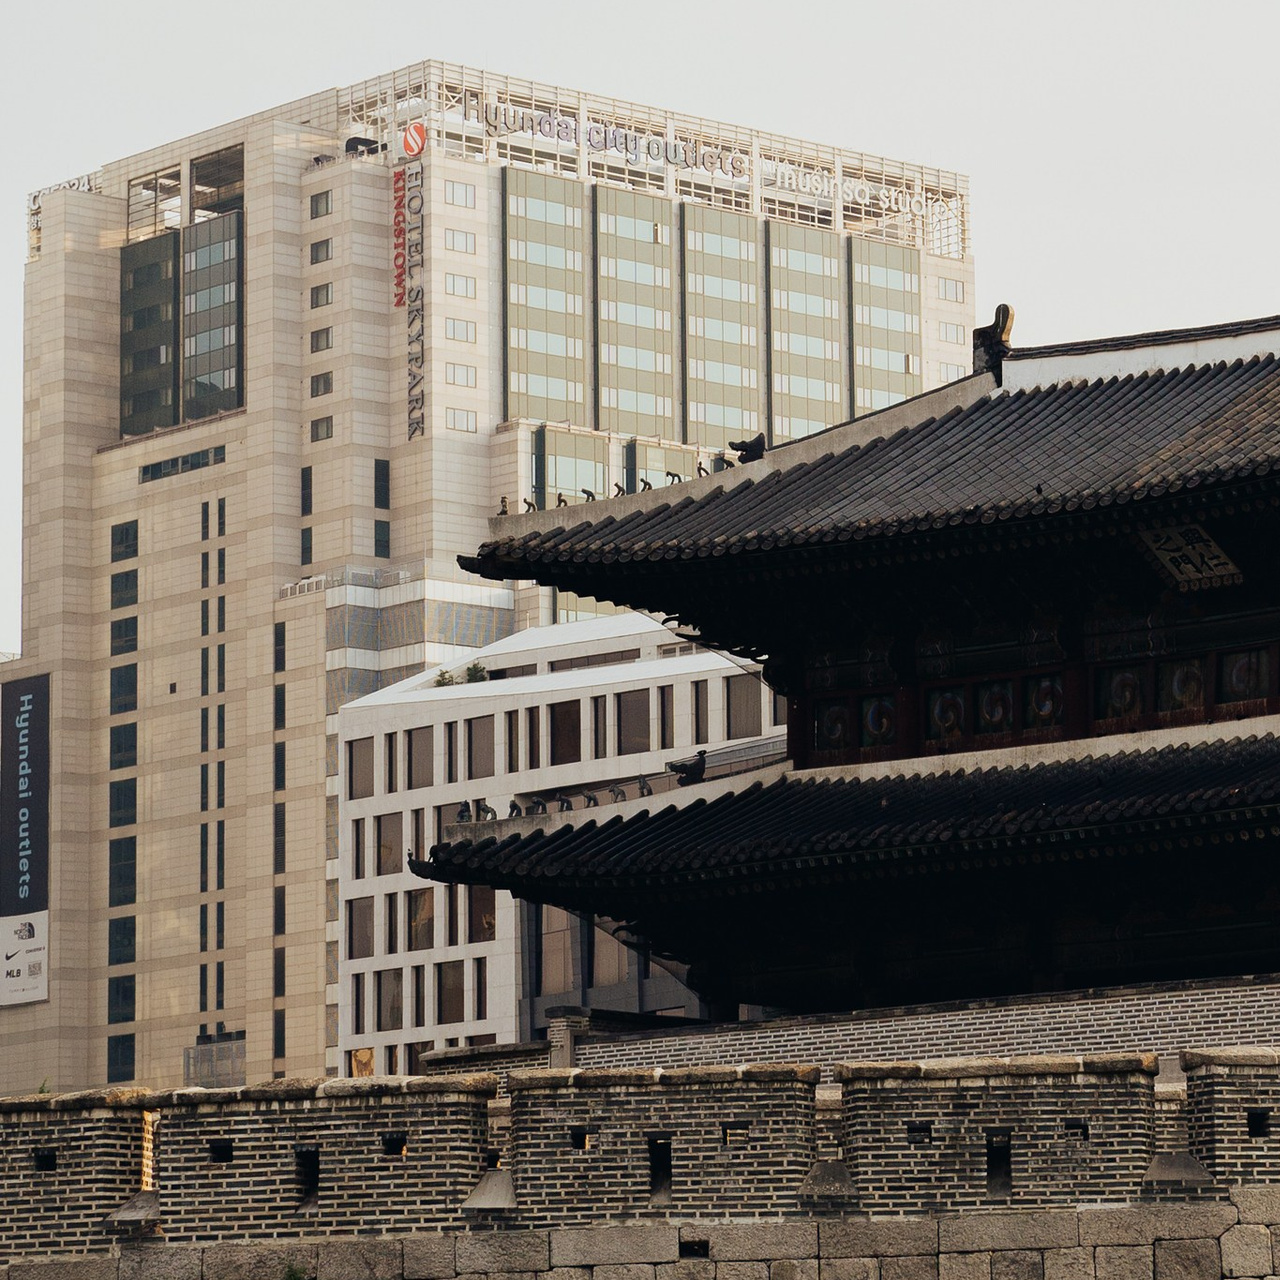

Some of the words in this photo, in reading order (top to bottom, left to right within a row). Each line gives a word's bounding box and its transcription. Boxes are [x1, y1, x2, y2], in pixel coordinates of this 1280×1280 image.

[588, 119, 641, 166] city
[648, 138, 746, 179] outlets
[776, 167, 870, 206] musinsa
[879, 186, 949, 219] studio
[393, 168, 406, 308] KINGSTOWN
[407, 162, 424, 280] HOTEL
[407, 285, 424, 442] SKYPARK
[16, 694, 33, 798] Hyundai
[18, 808, 32, 899] outlets
[6, 969, 21, 978] MLB
